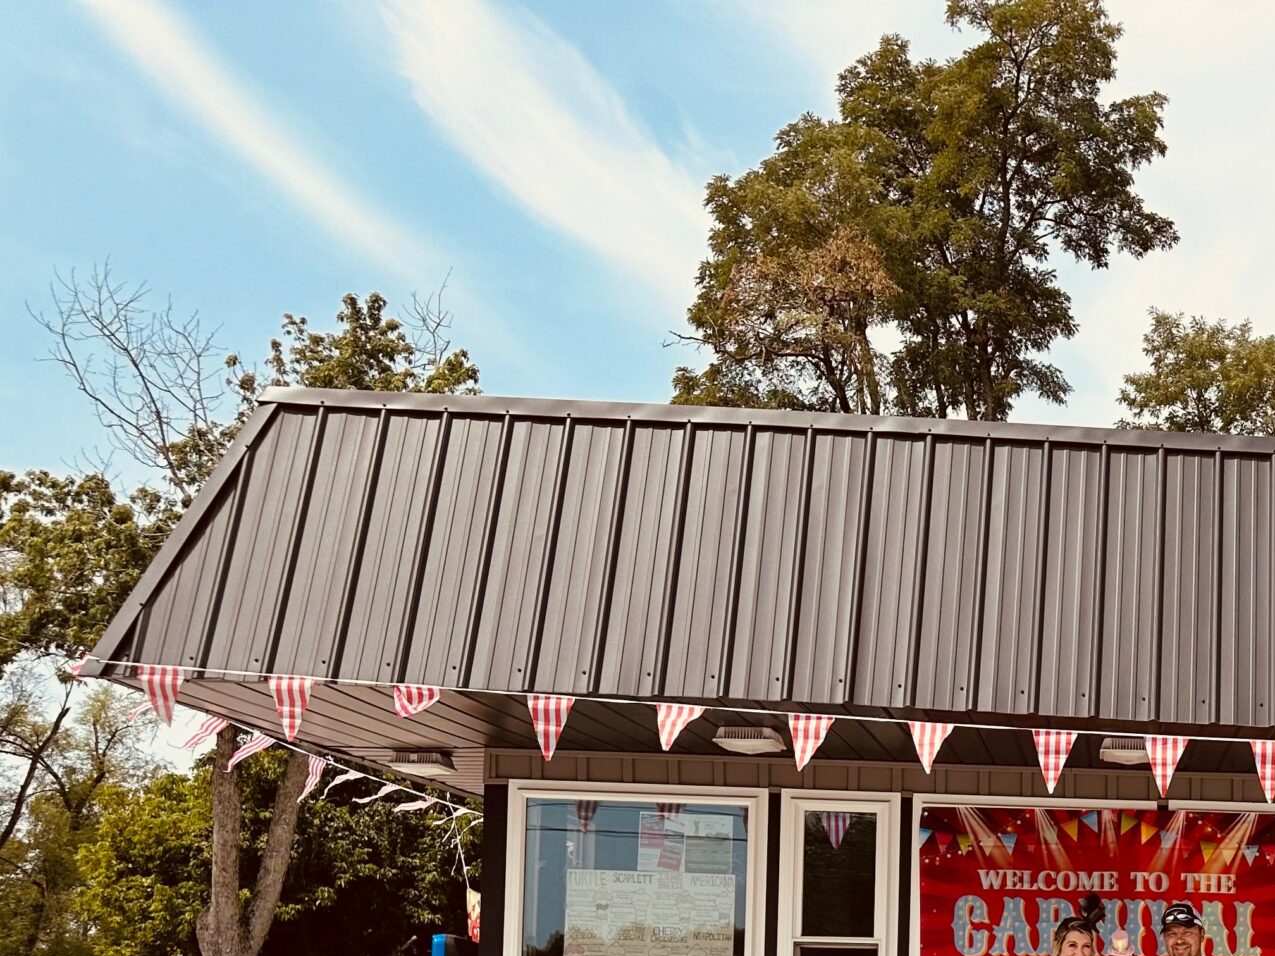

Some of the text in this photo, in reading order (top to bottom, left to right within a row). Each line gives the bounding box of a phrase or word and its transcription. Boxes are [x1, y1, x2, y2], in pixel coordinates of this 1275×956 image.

[568, 871, 607, 886] TURTLE
[977, 869, 1237, 895] WELCOME TO THE
